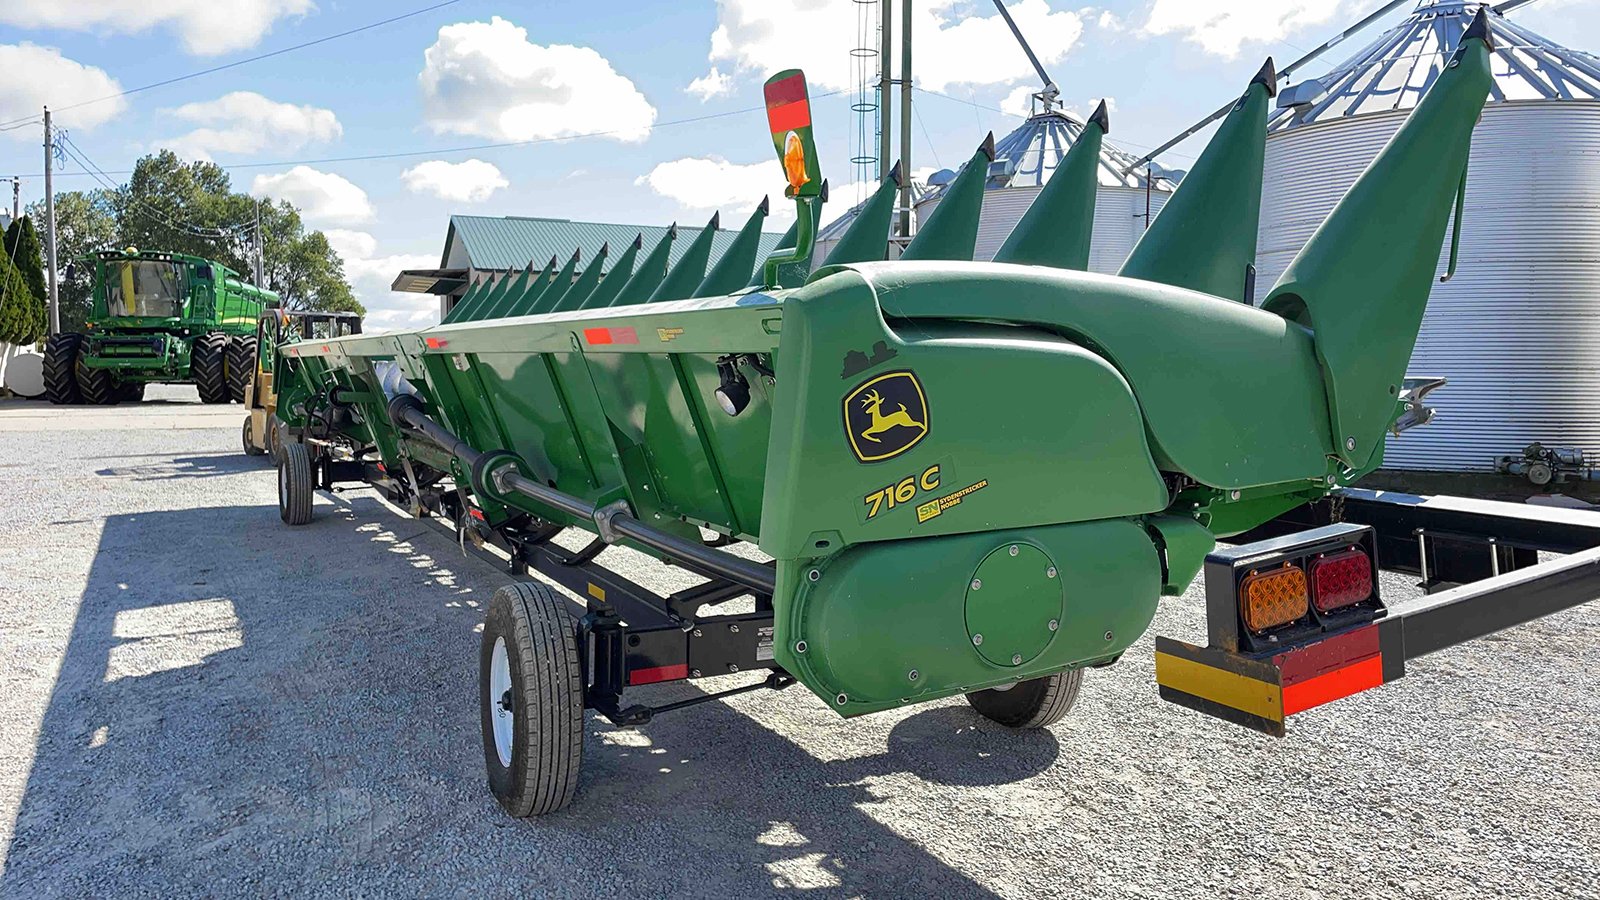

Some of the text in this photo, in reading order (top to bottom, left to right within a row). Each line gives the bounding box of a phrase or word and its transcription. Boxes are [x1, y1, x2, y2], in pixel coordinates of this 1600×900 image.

[865, 465, 940, 519] 716 C
[939, 479, 988, 504] SYDENSTRICKER
[919, 501, 938, 516] SN
